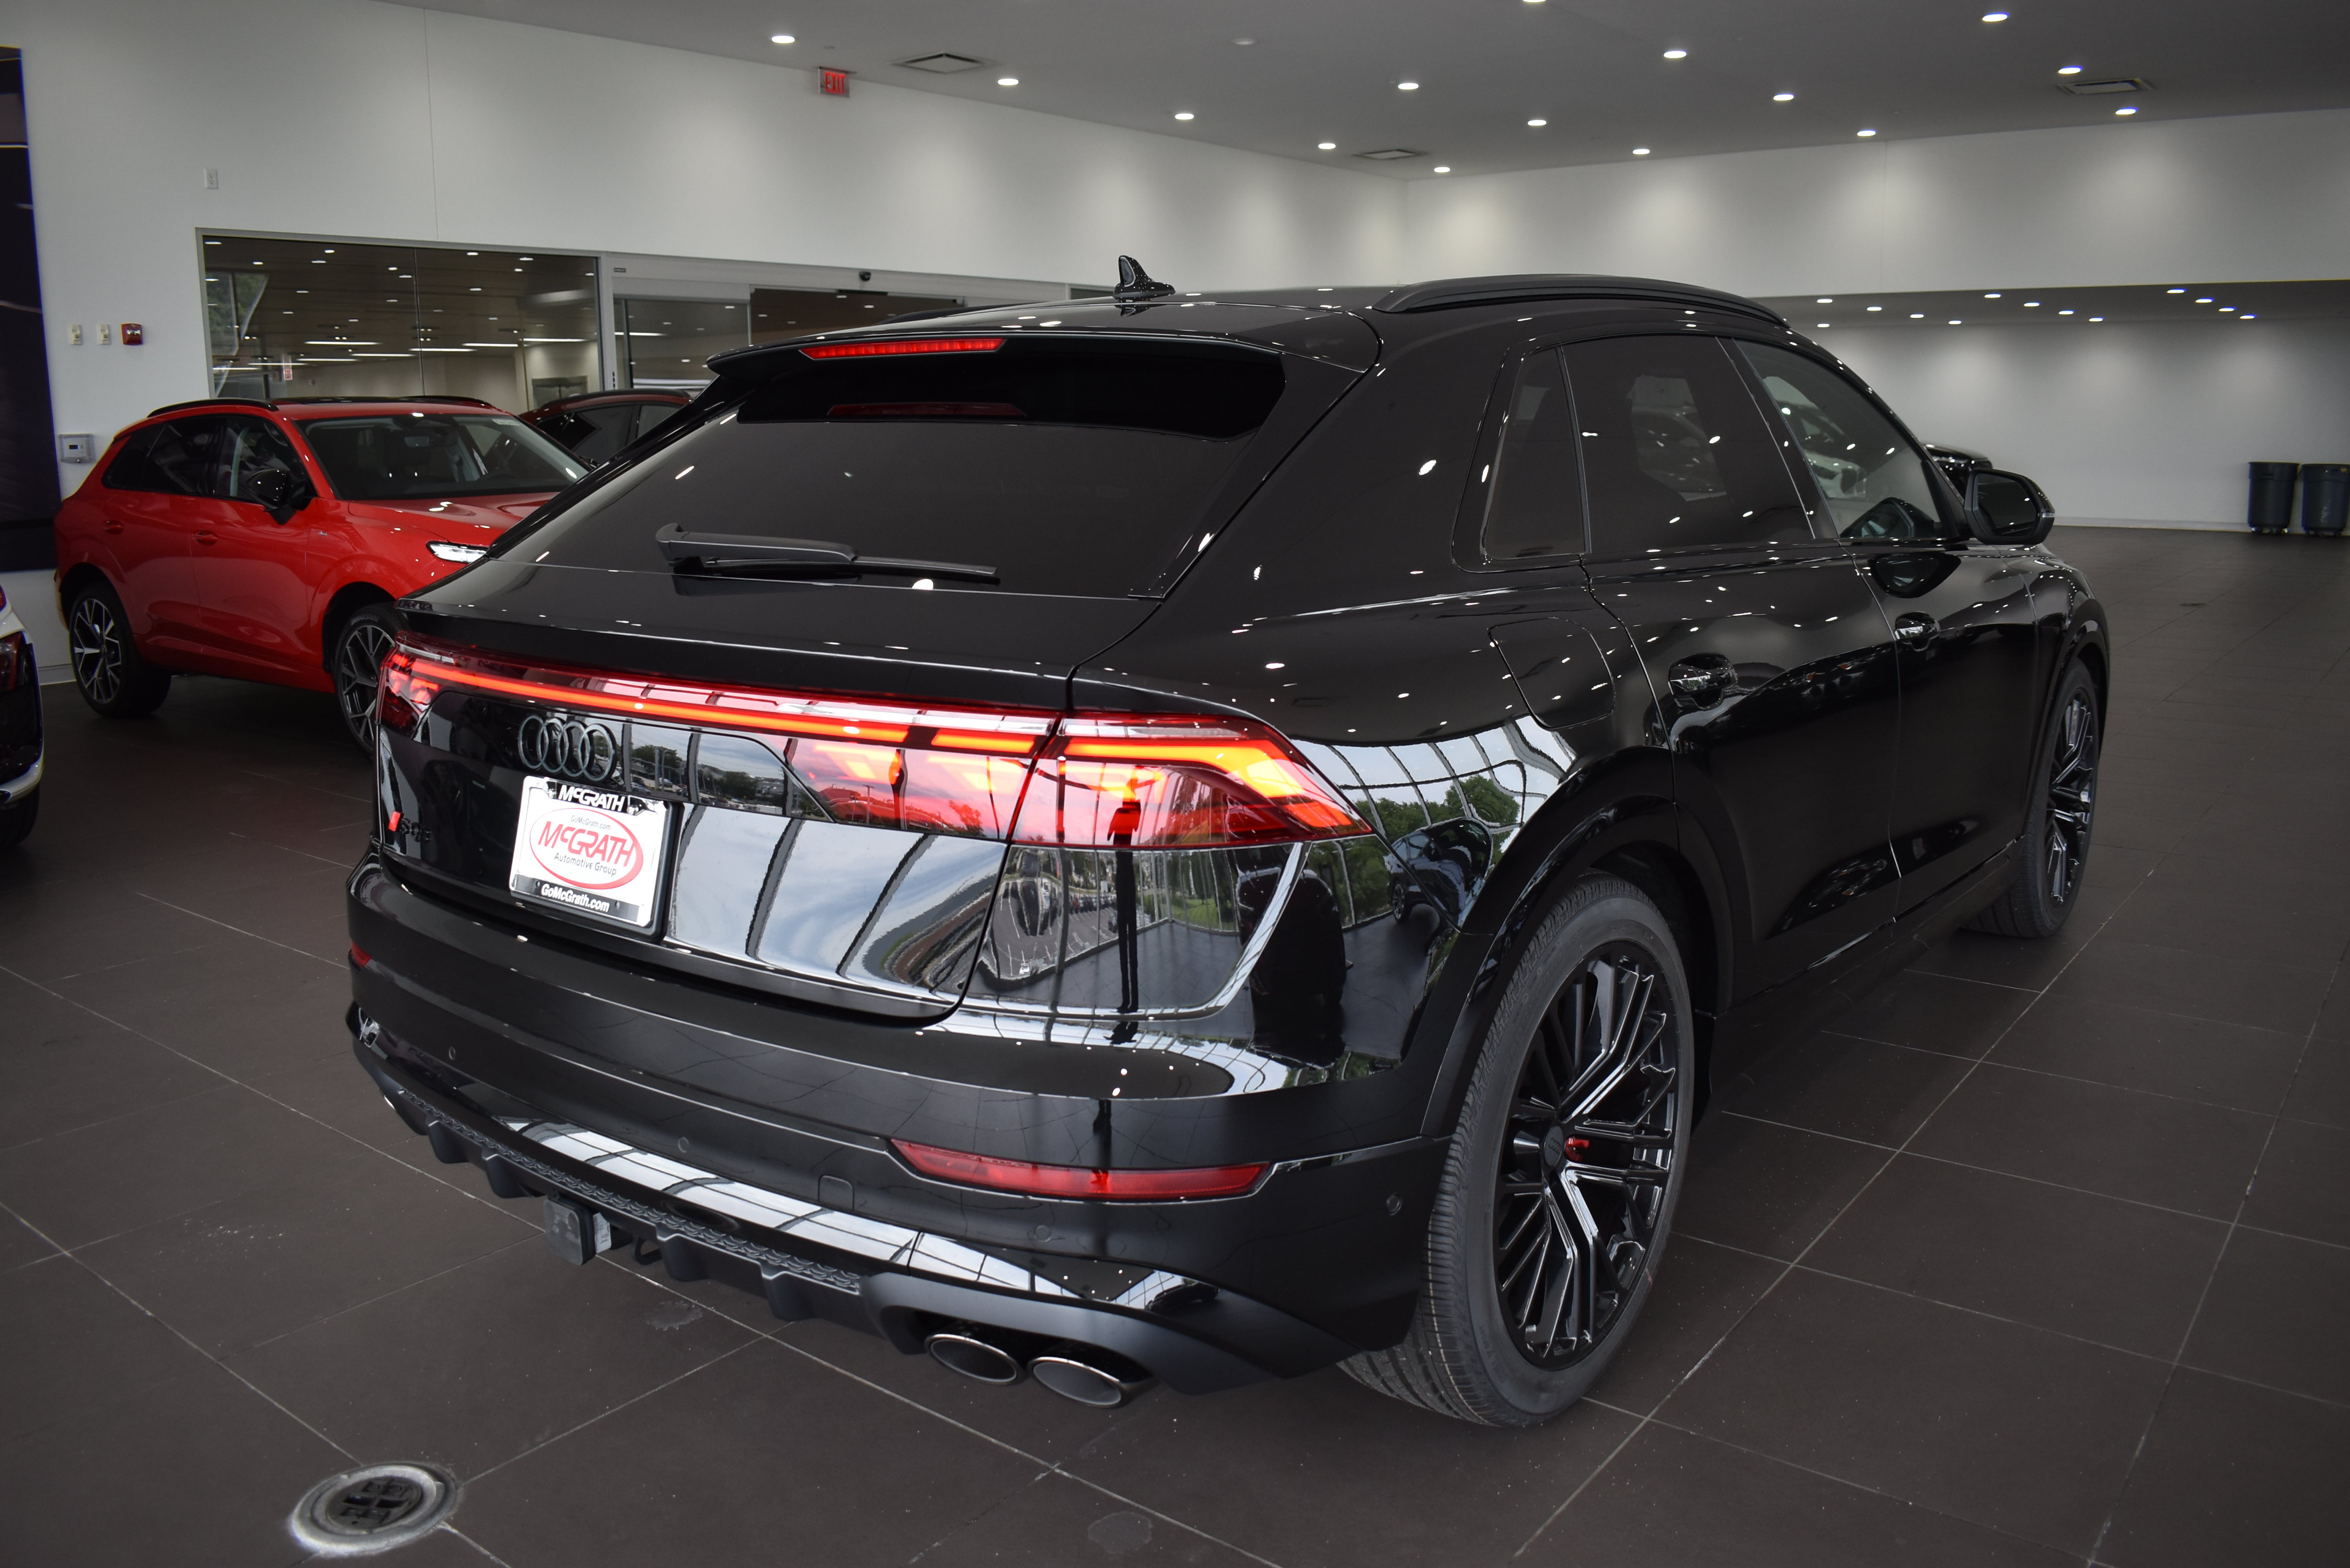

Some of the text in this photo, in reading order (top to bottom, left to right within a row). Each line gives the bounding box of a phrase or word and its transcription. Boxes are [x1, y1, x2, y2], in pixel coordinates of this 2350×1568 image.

[825, 71, 845, 95] EXIT
[570, 815, 611, 831] GoMcGrath.com
[554, 852, 617, 877] Automotive Group
[541, 883, 610, 913] GoMcGrath.com
